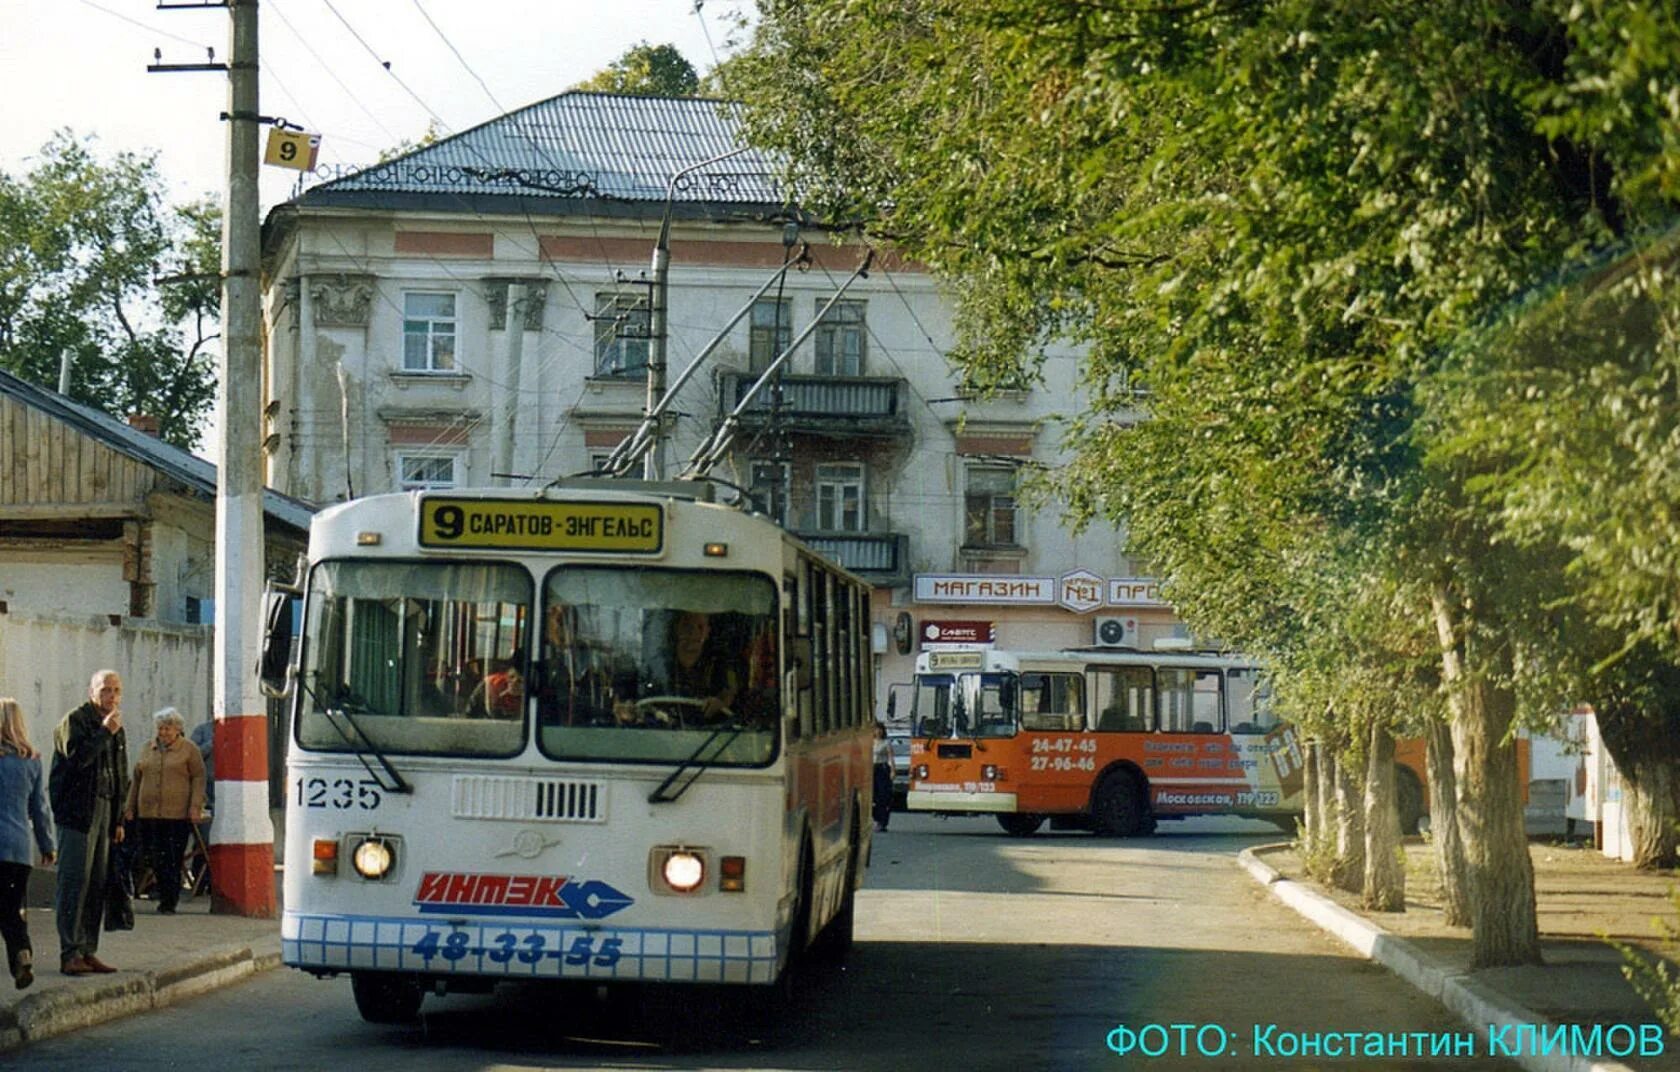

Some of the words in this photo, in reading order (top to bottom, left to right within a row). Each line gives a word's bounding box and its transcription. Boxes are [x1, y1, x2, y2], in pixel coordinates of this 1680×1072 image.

[280, 141, 297, 161] 9
[433, 505, 464, 540] 9
[470, 513, 552, 536] САРАТОВ
[565, 516, 652, 539] ЭНГЕЛЬС
[934, 581, 1040, 598] МАГАЗИН
[1066, 585, 1099, 602] №1
[1032, 738, 1097, 753] 24-47-45
[1031, 756, 1095, 771] 27-96-46
[297, 777, 381, 809] 1235
[413, 931, 624, 966] 48-33-55
